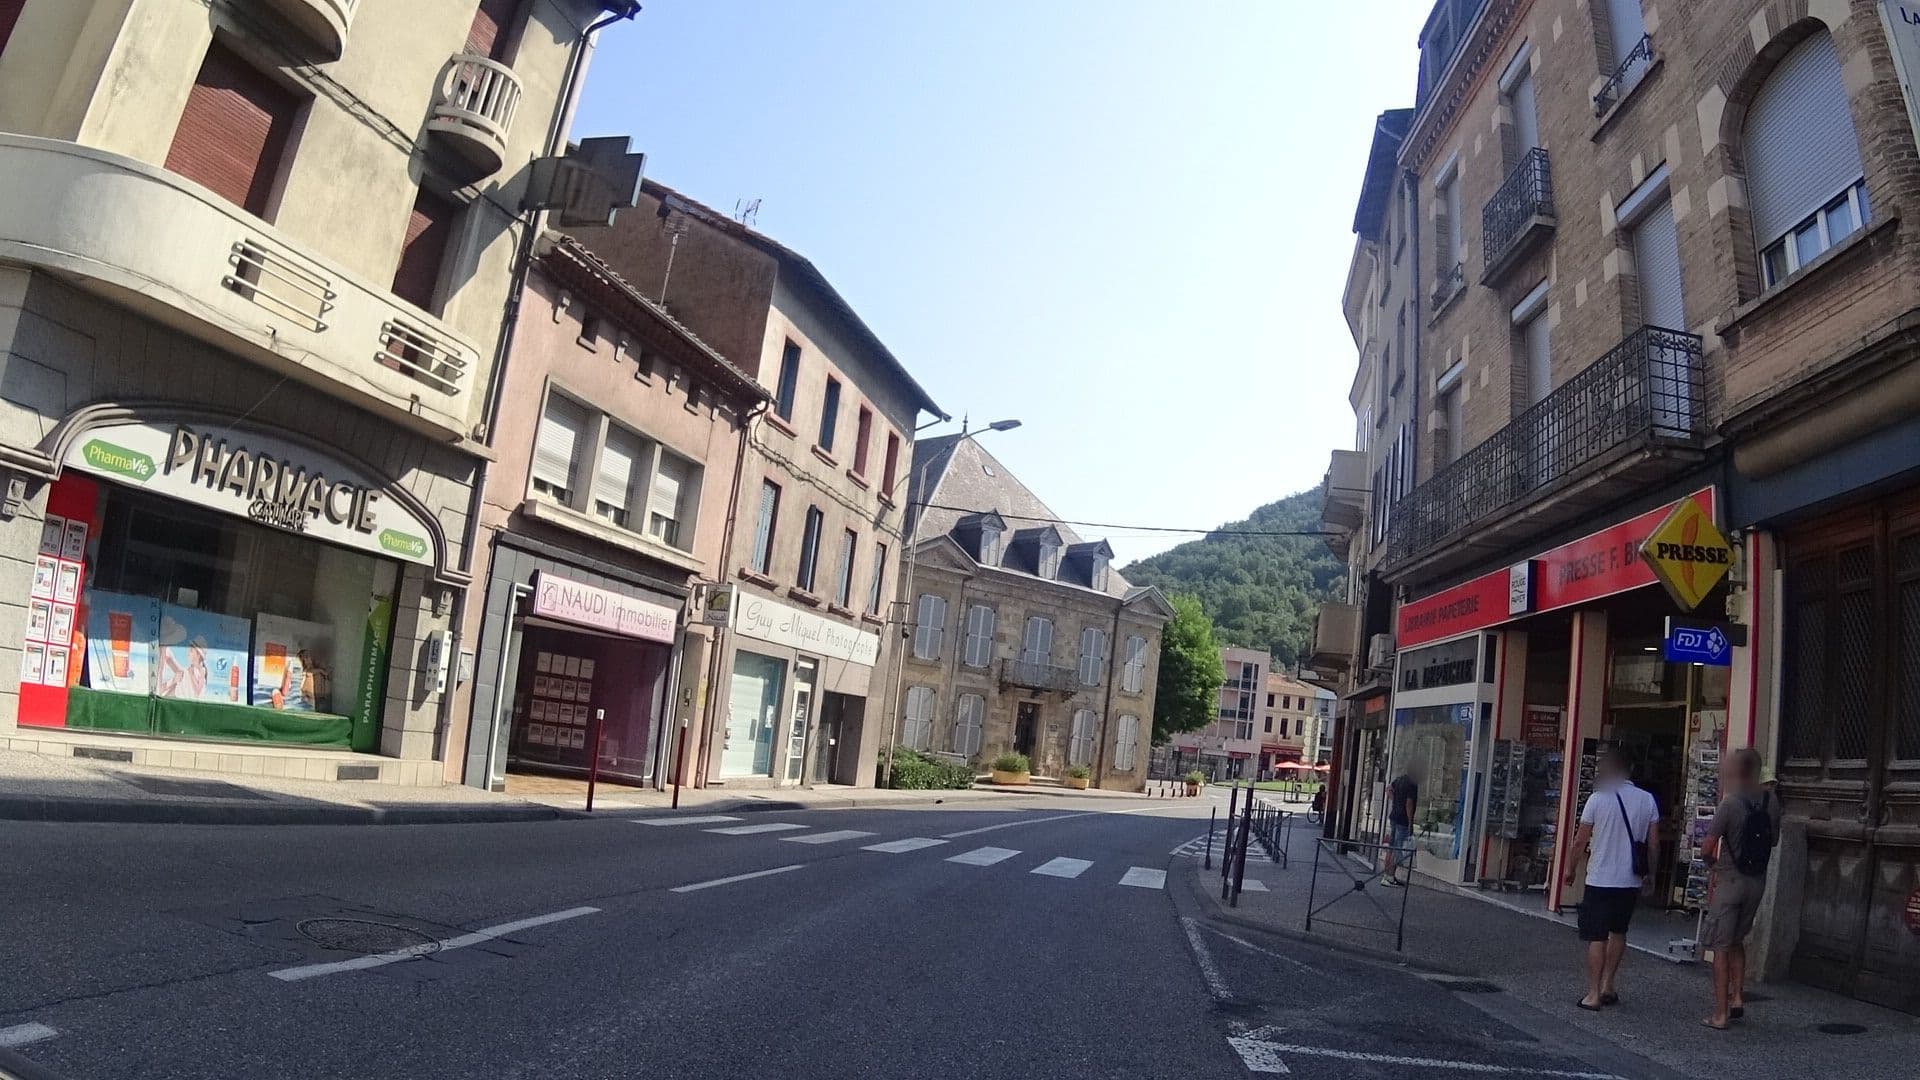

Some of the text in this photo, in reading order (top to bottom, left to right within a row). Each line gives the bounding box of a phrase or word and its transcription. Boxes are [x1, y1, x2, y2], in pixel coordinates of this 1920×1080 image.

[89, 445, 149, 475] PharmaVie
[166, 426, 383, 533] PHARMACIE
[383, 533, 423, 553] PharmaVie
[1657, 543, 1728, 564] PRESSE
[1560, 552, 1605, 585] PRESSE
[561, 586, 608, 616] NAUDI
[612, 601, 672, 631] immobilier
[747, 602, 872, 656] Guy Miquel Photographe
[1677, 633, 1702, 647] FDJ
[362, 620, 382, 724] PARAPHARMACIE
